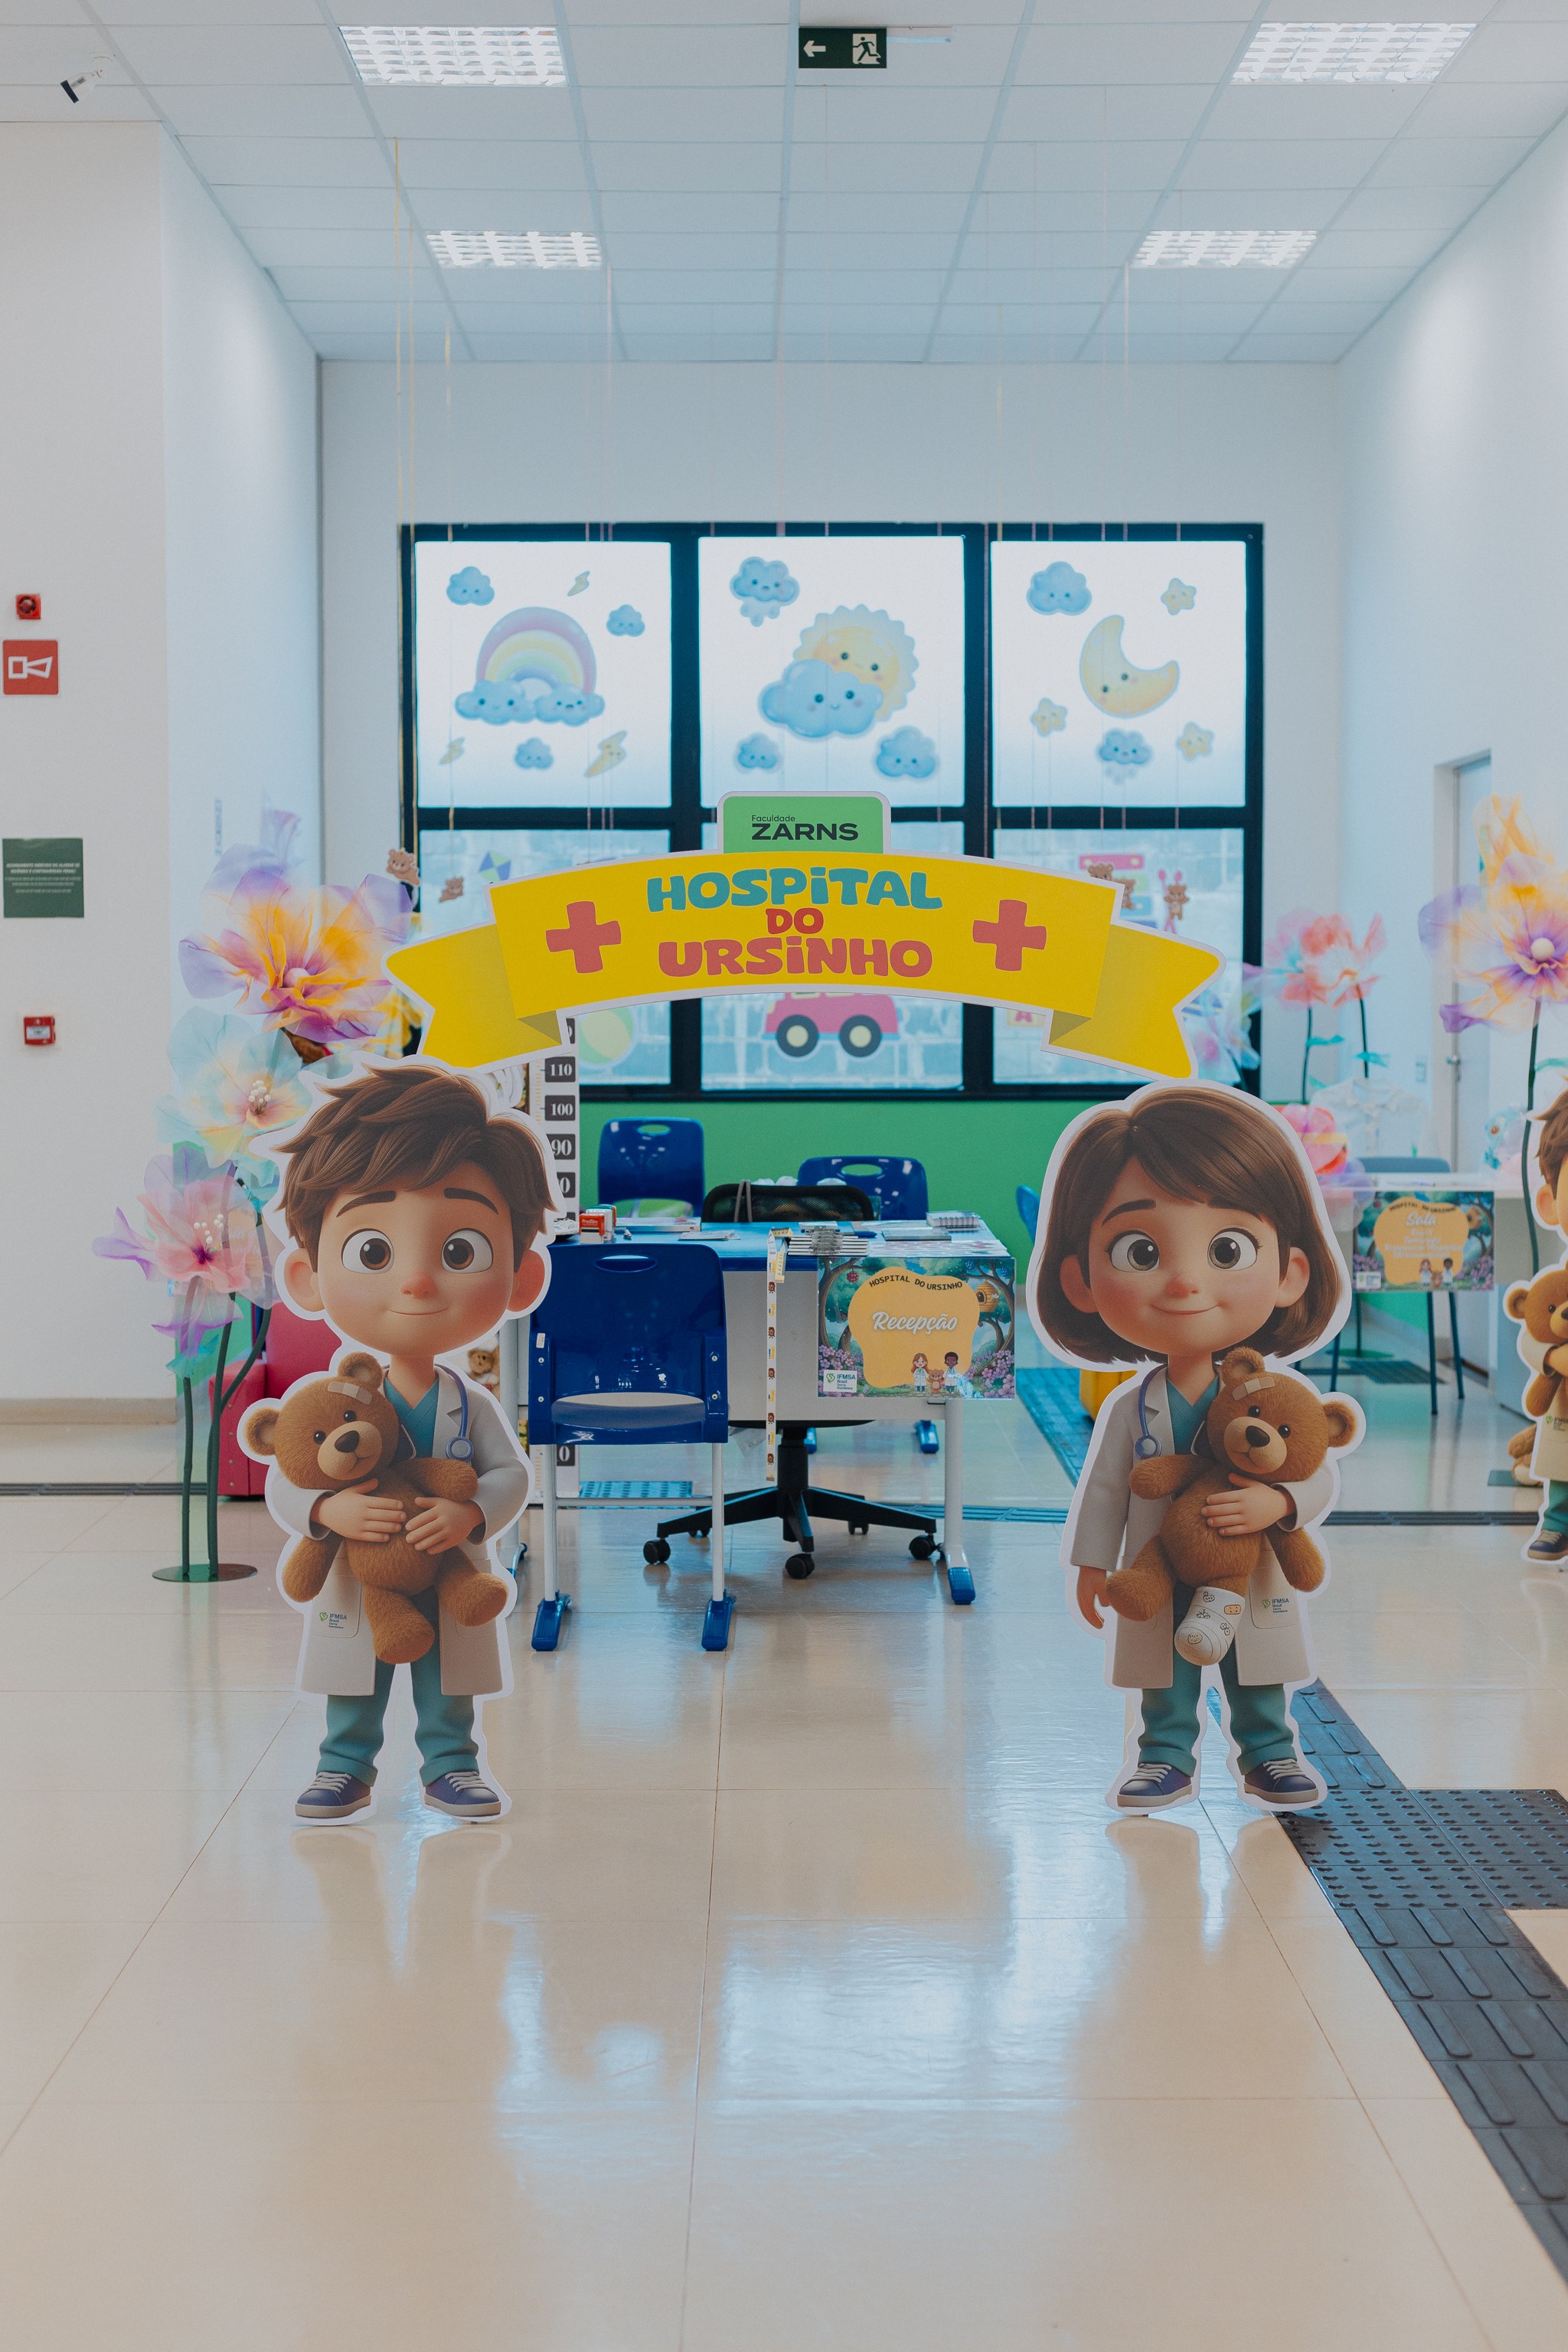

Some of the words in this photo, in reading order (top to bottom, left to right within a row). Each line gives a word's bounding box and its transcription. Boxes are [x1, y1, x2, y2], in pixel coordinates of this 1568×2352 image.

[751, 815, 795, 823] Faculdade
[751, 823, 859, 841] ZARNS
[765, 907, 825, 935] DO
[549, 1063, 573, 1076] 110
[550, 1102, 574, 1116] 100
[551, 1138, 572, 1156] 90
[869, 1275, 910, 1288] HOSPITAL
[914, 1279, 926, 1288] DO
[926, 1281, 963, 1291] URSINHO
[871, 1311, 958, 1335] Recepção
